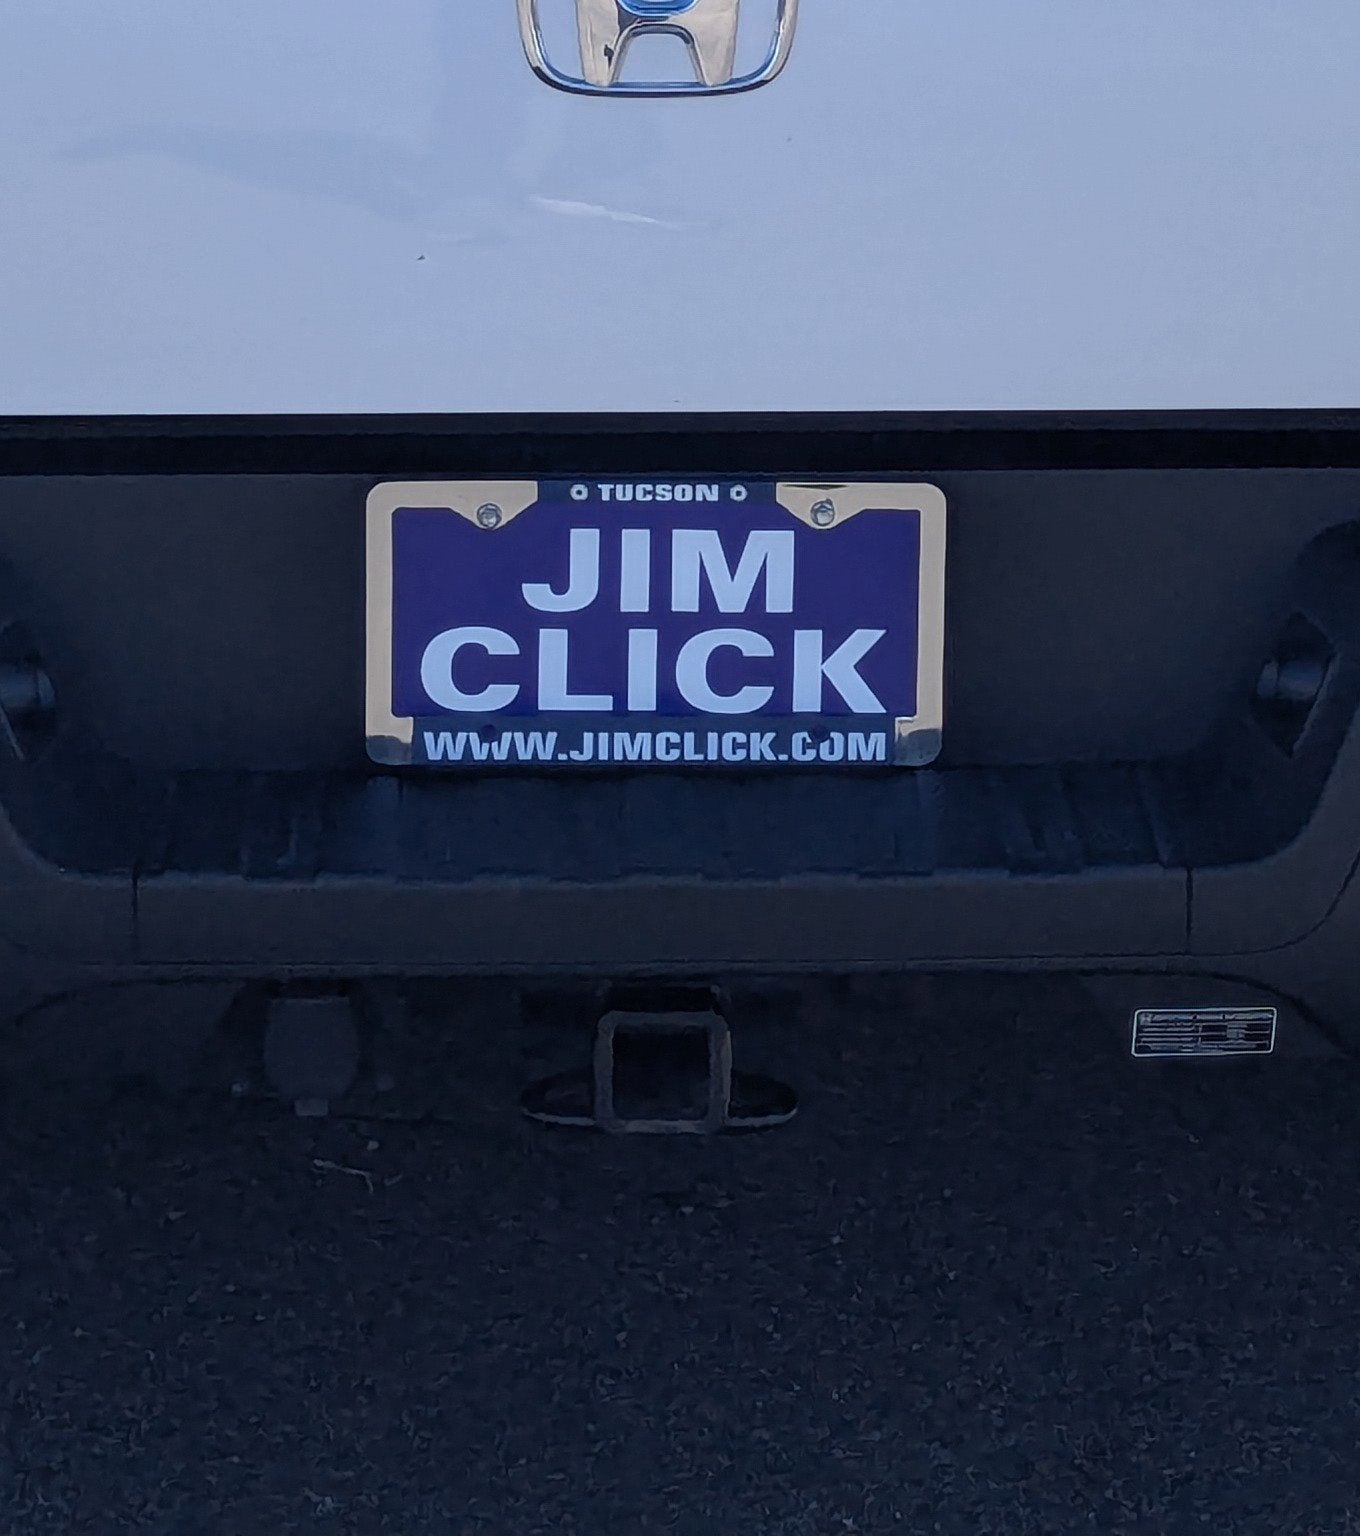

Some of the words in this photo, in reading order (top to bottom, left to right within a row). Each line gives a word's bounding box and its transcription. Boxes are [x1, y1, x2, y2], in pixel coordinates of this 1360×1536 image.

[598, 484, 719, 502] TUCSON
[521, 527, 795, 614] JIM
[420, 626, 887, 714] CLICK
[423, 730, 887, 763] WWW.JIMCLICK.COM
